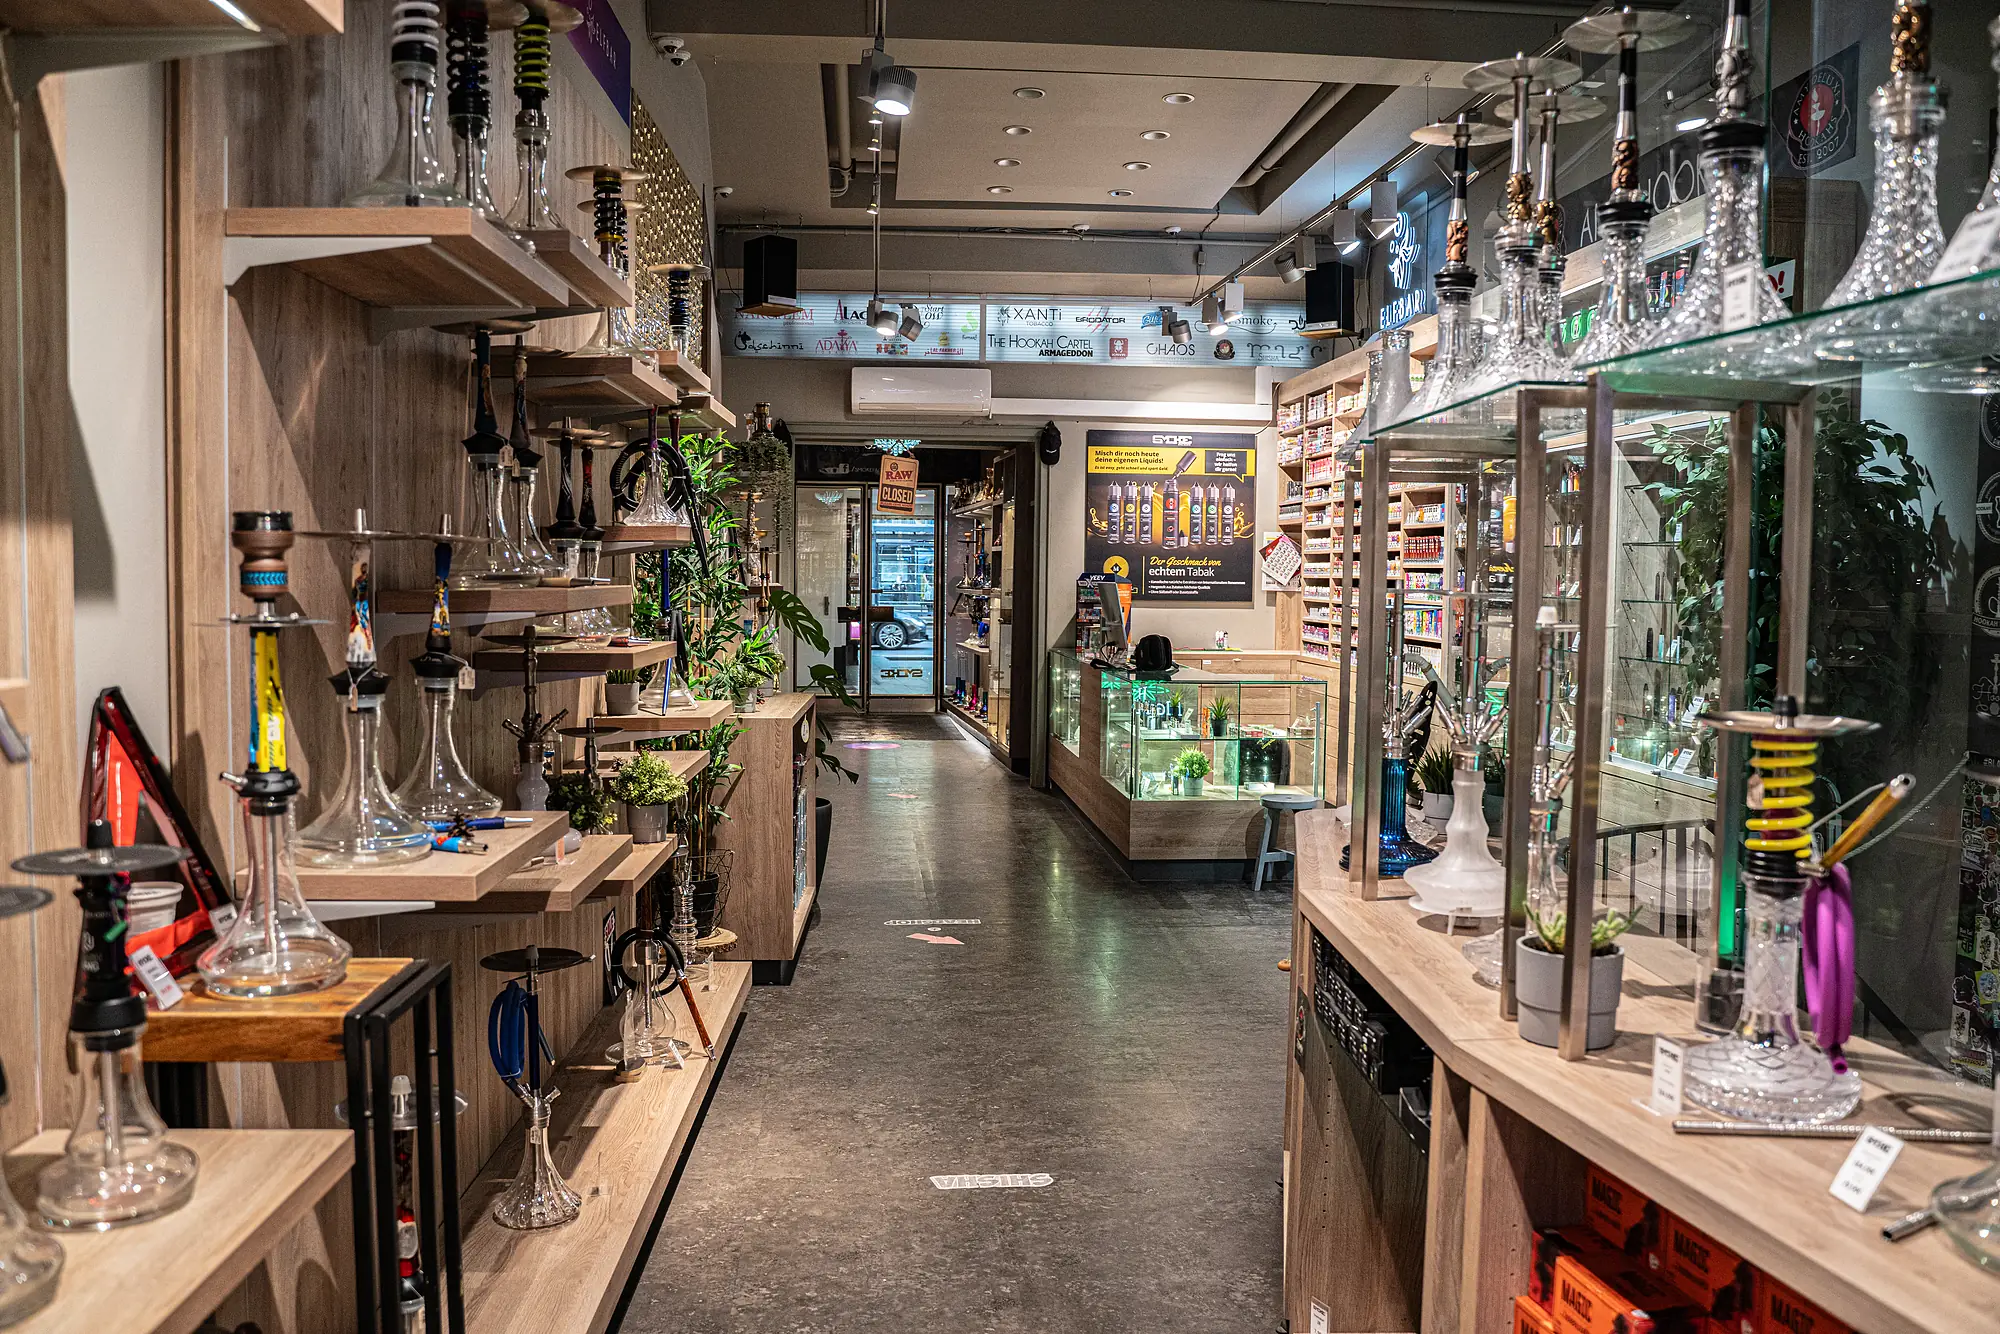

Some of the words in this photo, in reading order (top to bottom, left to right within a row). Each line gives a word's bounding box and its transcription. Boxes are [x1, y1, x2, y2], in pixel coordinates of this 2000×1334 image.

[595, 22, 617, 70] ELFBAR
[1816, 136, 1839, 160] 2007
[1380, 288, 1424, 330] ELFBAR
[987, 333, 1006, 348] THE
[1009, 334, 1054, 349] HOOKAH
[1056, 335, 1094, 350] CARTEL
[1146, 342, 1196, 356] CHAOS
[1038, 349, 1094, 357] ARMAGEDDON
[1113, 457, 1139, 465] eigenen
[885, 470, 914, 480] RAW
[882, 486, 913, 504] CLOSED
[1149, 556, 1165, 566] Der
[1166, 556, 1208, 568] Geschmack
[1208, 559, 1222, 567] von
[1148, 567, 1186, 577] echtem
[1186, 567, 1215, 577] Tabak
[929, 1172, 1054, 1190] SHISHA
[1674, 1228, 1710, 1274] MAGIC
[1562, 1278, 1593, 1323] MAGIC
